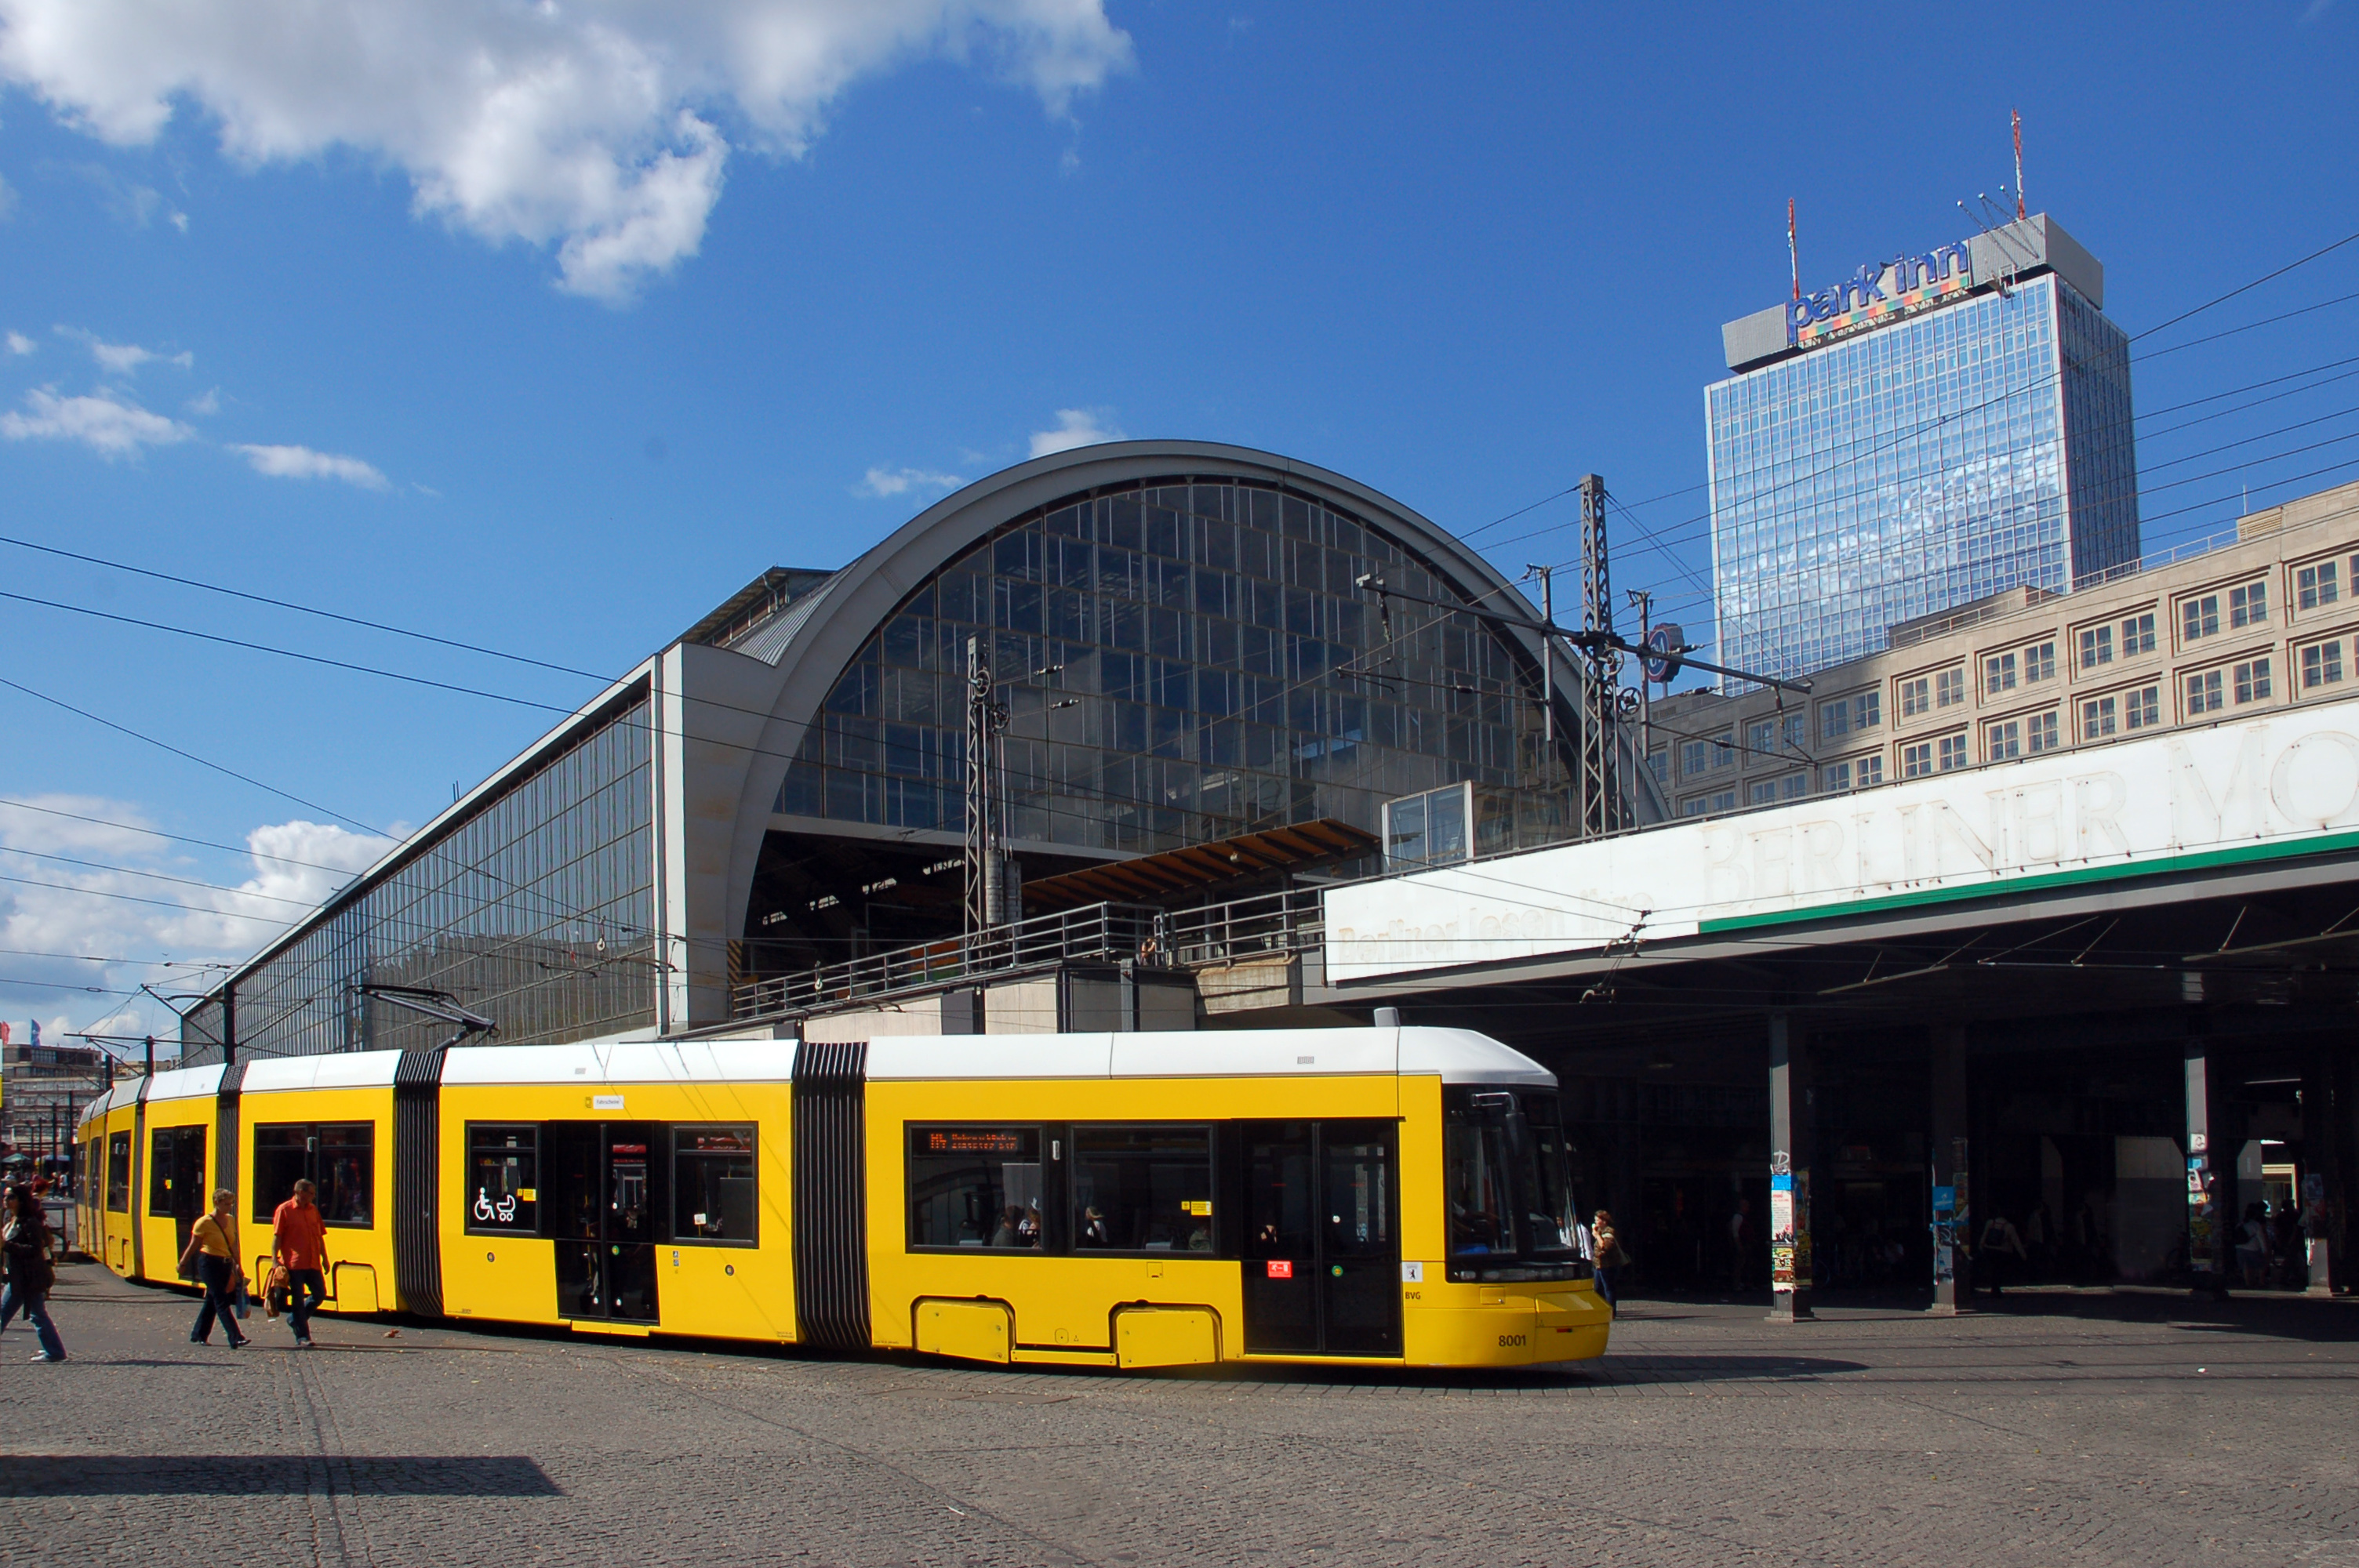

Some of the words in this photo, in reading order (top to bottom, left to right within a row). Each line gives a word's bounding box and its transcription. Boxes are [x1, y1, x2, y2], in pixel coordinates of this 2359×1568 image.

[1786, 263, 1887, 343] park
[1895, 240, 1968, 294] inn
[1697, 771, 2132, 913] BERLINER
[1338, 919, 1459, 964] Berliner
[1470, 906, 1565, 948] lesen
[1405, 1291, 1420, 1300] BVG
[1498, 1334, 1526, 1347] 8001
